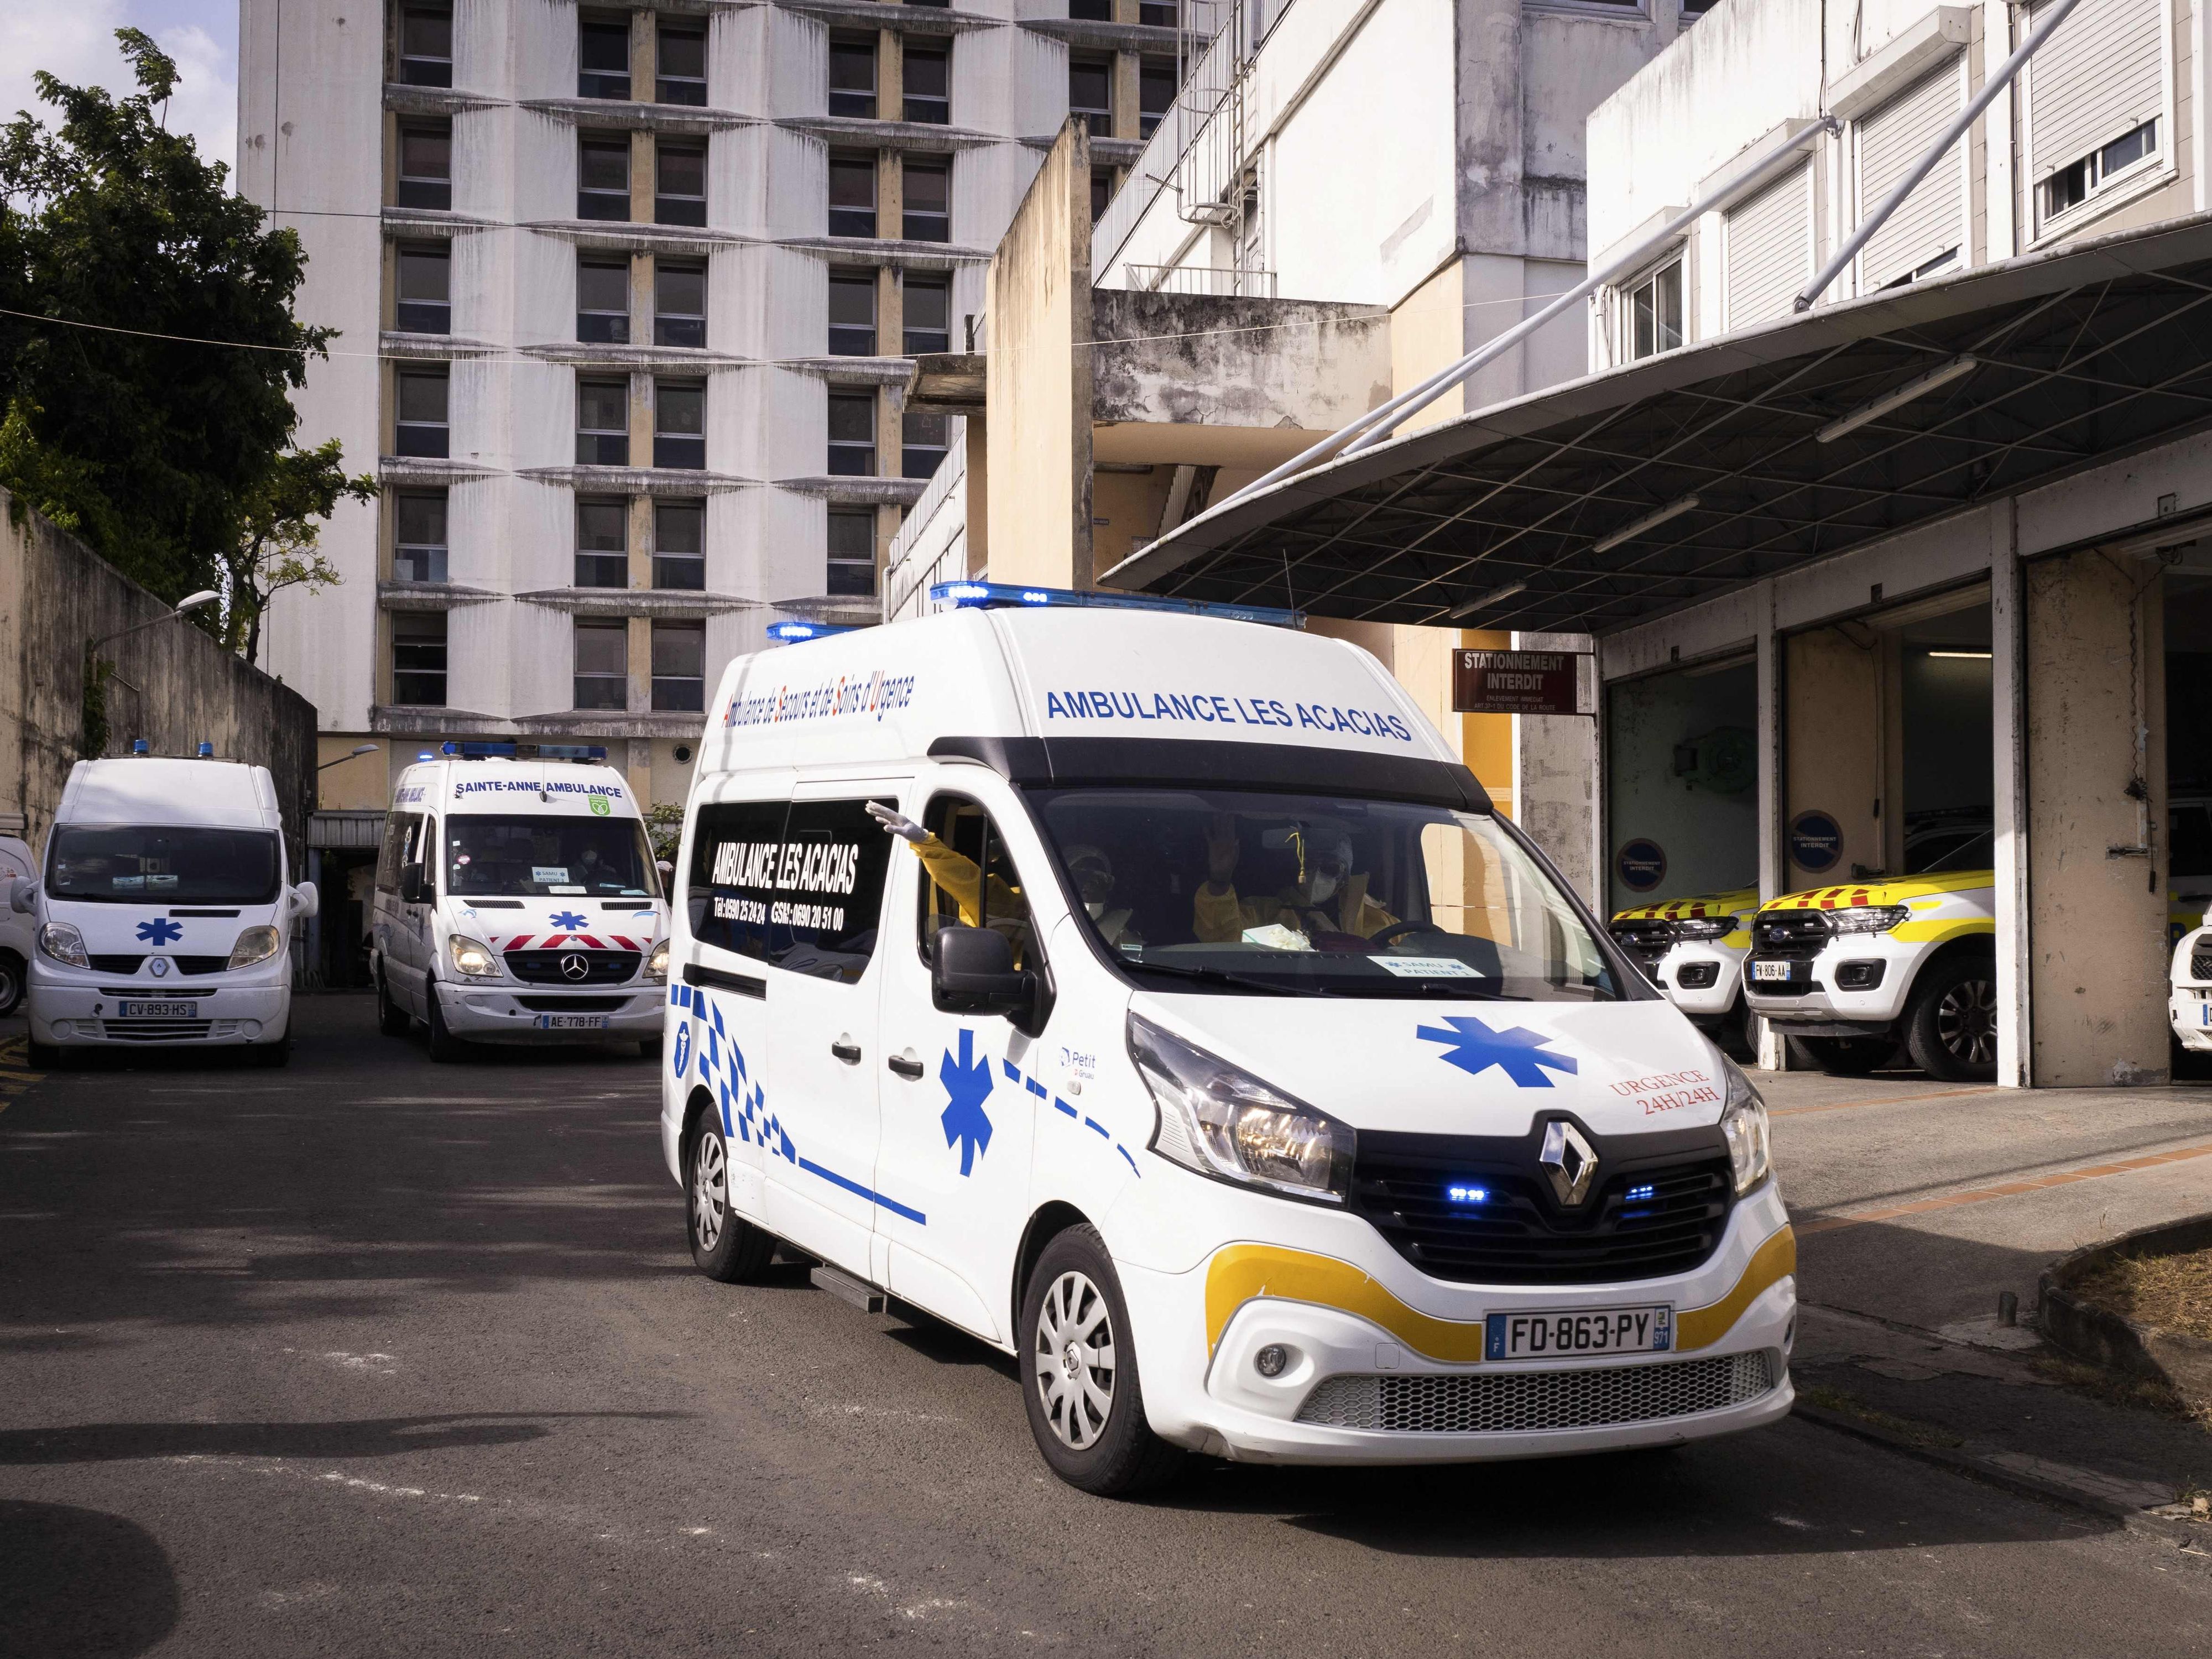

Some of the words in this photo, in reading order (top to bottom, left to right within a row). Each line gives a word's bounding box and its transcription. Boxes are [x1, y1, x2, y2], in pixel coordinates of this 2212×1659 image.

[1465, 653, 1564, 671] STATIONNEMENT
[1487, 672, 1543, 690] INTERDIT
[721, 691, 765, 728] Ambulance
[763, 687, 776, 724] de
[775, 685, 811, 723] Secours
[809, 682, 823, 718] et
[820, 678, 833, 717] de
[832, 674, 862, 716] Soins
[861, 670, 914, 722] d'Urgence
[1047, 691, 1236, 723] AMBULANCE
[1234, 698, 1293, 727] LES
[1296, 703, 1412, 742] ACACIAS
[456, 781, 542, 794] SAINTE-ANNE
[546, 782, 622, 798] AMBULANCE
[712, 842, 778, 889] AMBULANCE
[776, 843, 802, 890] LES
[799, 843, 858, 894] ACACIAS
[739, 900, 749, 921] 25
[748, 901, 758, 922] 24
[756, 902, 766, 925] 24
[811, 905, 821, 928] 20
[822, 907, 832, 930] 51
[833, 907, 844, 931] 00
[129, 1004, 186, 1015] CV-893-HS
[551, 1017, 601, 1027] AE-778-FF
[1072, 1052, 1095, 1068] Petit
[1609, 1070, 1710, 1096] URGENCE
[1636, 1087, 1720, 1115] 24H/24H
[1511, 1313, 1649, 1352] FD-863-PY
[1654, 1331, 1668, 1344] 971
